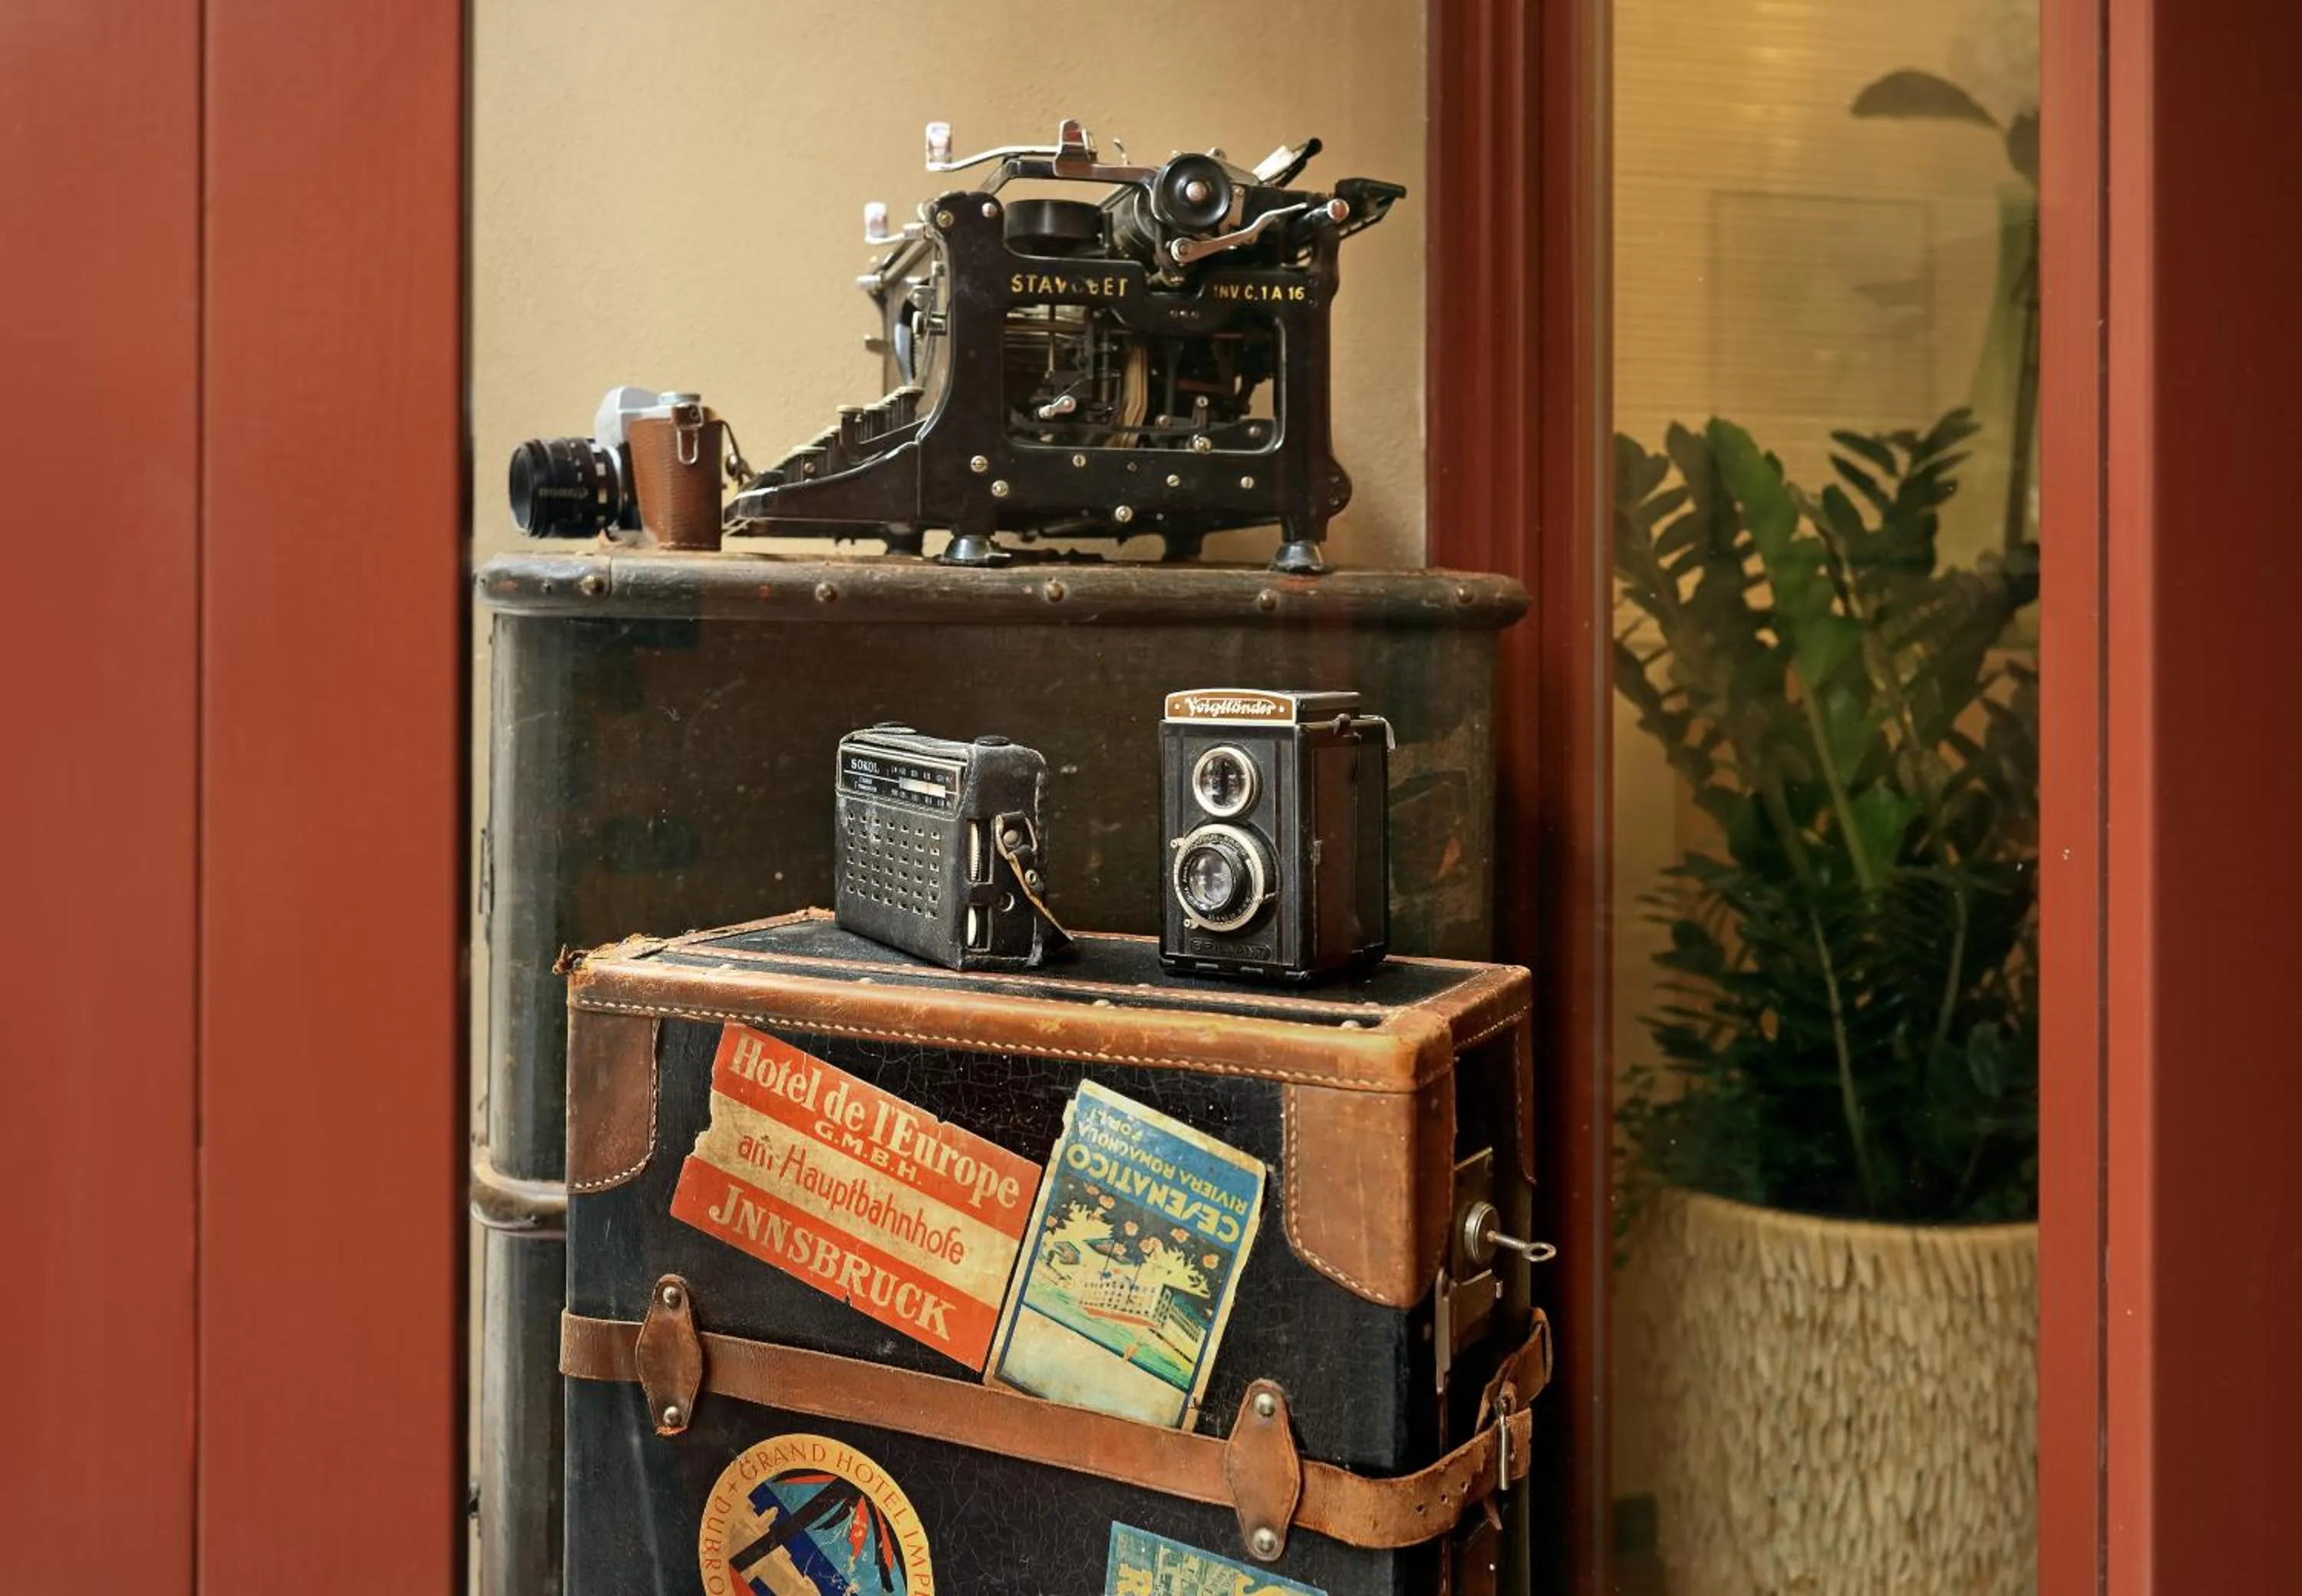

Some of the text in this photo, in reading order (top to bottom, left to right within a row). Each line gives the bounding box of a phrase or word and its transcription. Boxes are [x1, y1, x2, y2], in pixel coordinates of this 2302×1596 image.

[851, 758, 879, 773] SOKOL
[728, 1031, 1020, 1209] Hotel de l'Europe
[738, 1133, 965, 1265] am Hauptbahnhofe
[1067, 1144, 1240, 1243] CESENATICO
[1077, 1122, 1248, 1214] RIVIERA ROMAGNOLA
[740, 1443, 826, 1481] GRAND
[836, 1450, 907, 1525] HOTEL
